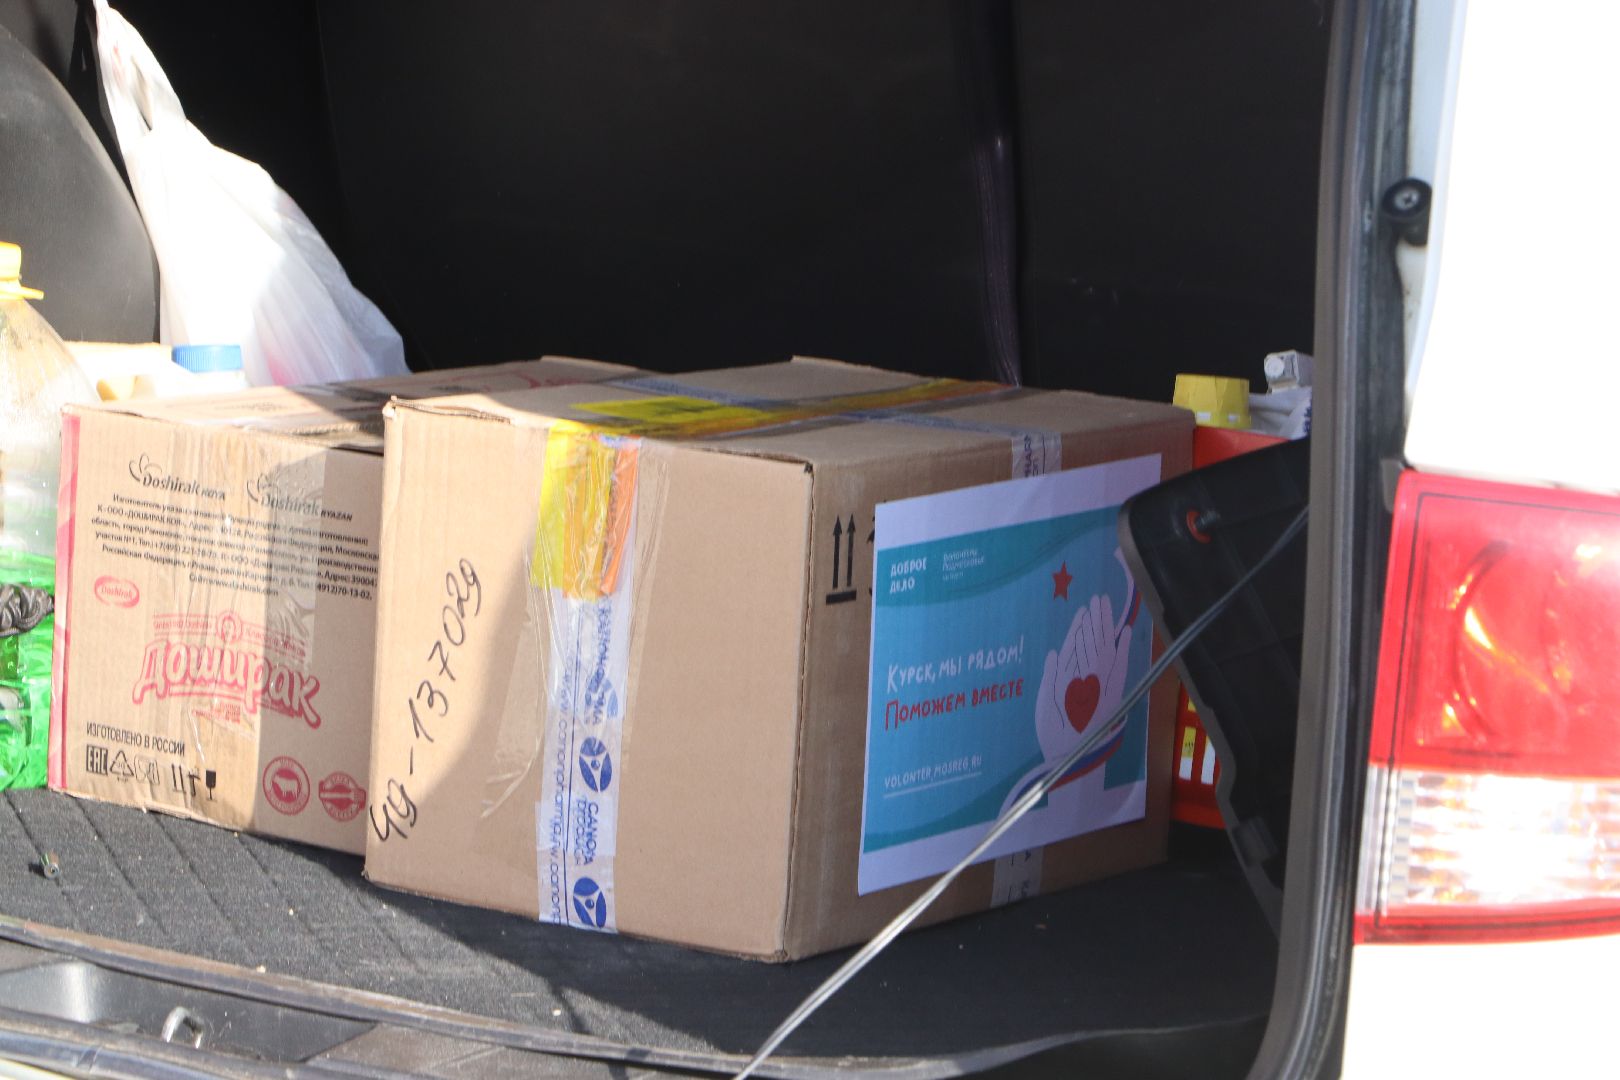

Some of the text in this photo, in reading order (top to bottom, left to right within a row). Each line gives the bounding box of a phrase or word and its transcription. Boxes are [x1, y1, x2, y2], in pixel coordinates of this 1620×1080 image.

[142, 473, 200, 496] Doshirak
[321, 509, 353, 522] RYAZAN
[890, 555, 928, 579] ДОБРОЕ
[889, 575, 916, 595] ДЕЛО
[132, 637, 322, 729] Доширак
[86, 721, 185, 757] ИЗГОТОВЛЕНО В РОССИИ
